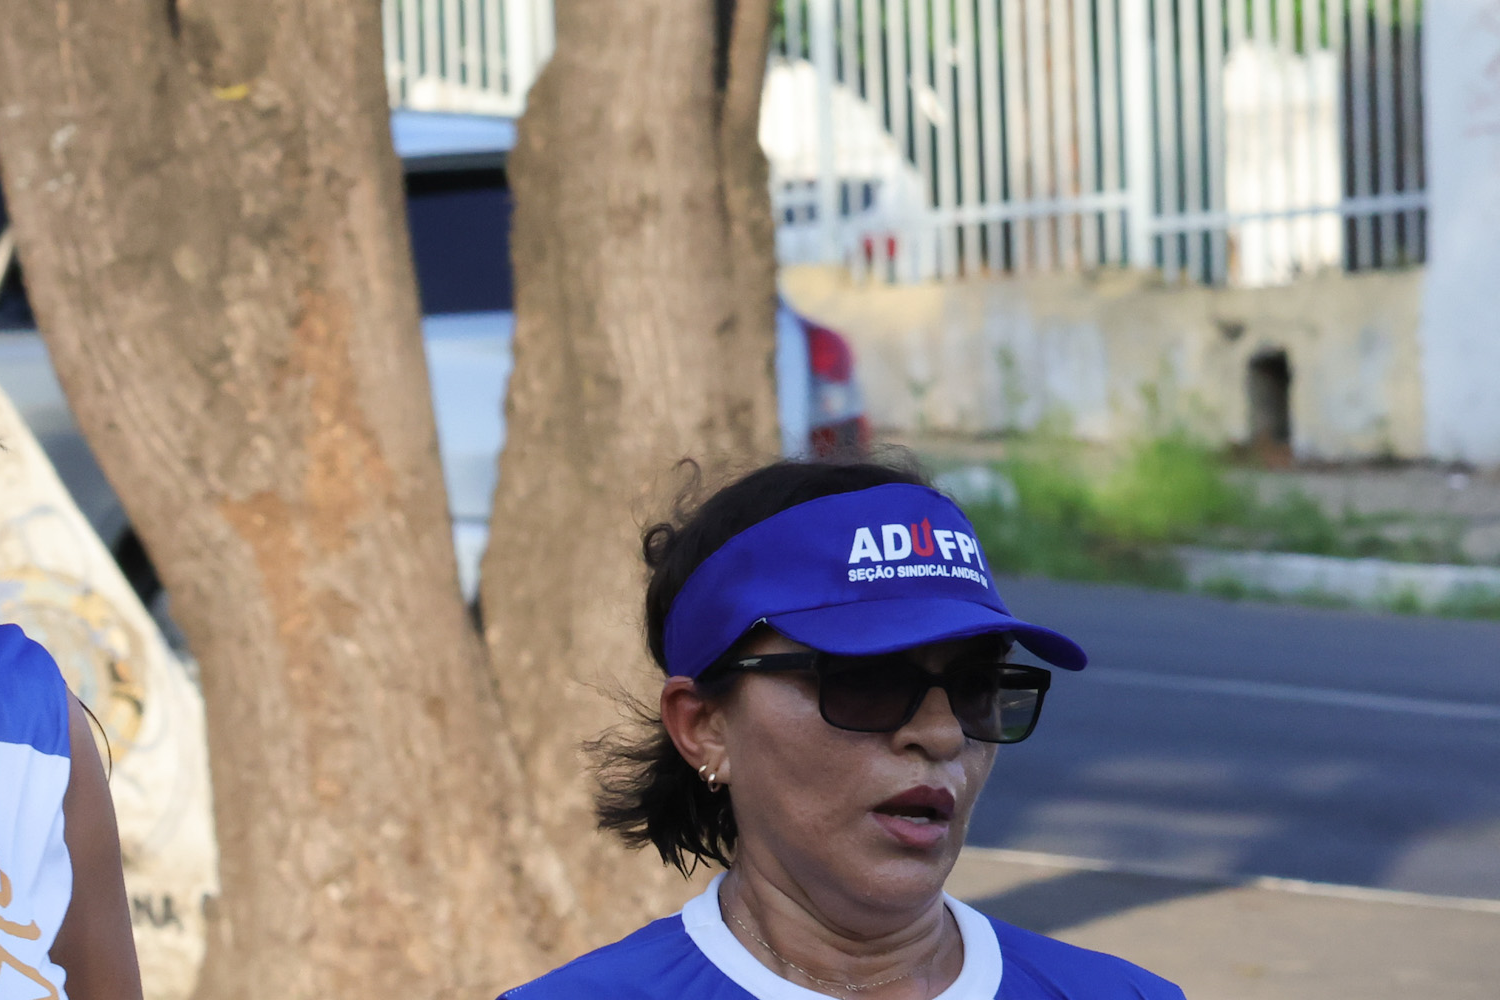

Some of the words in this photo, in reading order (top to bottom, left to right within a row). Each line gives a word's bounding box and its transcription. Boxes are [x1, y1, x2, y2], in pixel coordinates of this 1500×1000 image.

[848, 517, 984, 571] ADUFPI
[848, 564, 895, 582] SEÇÃO
[897, 564, 950, 578] SINDICAL
[951, 566, 980, 583] ANDES
